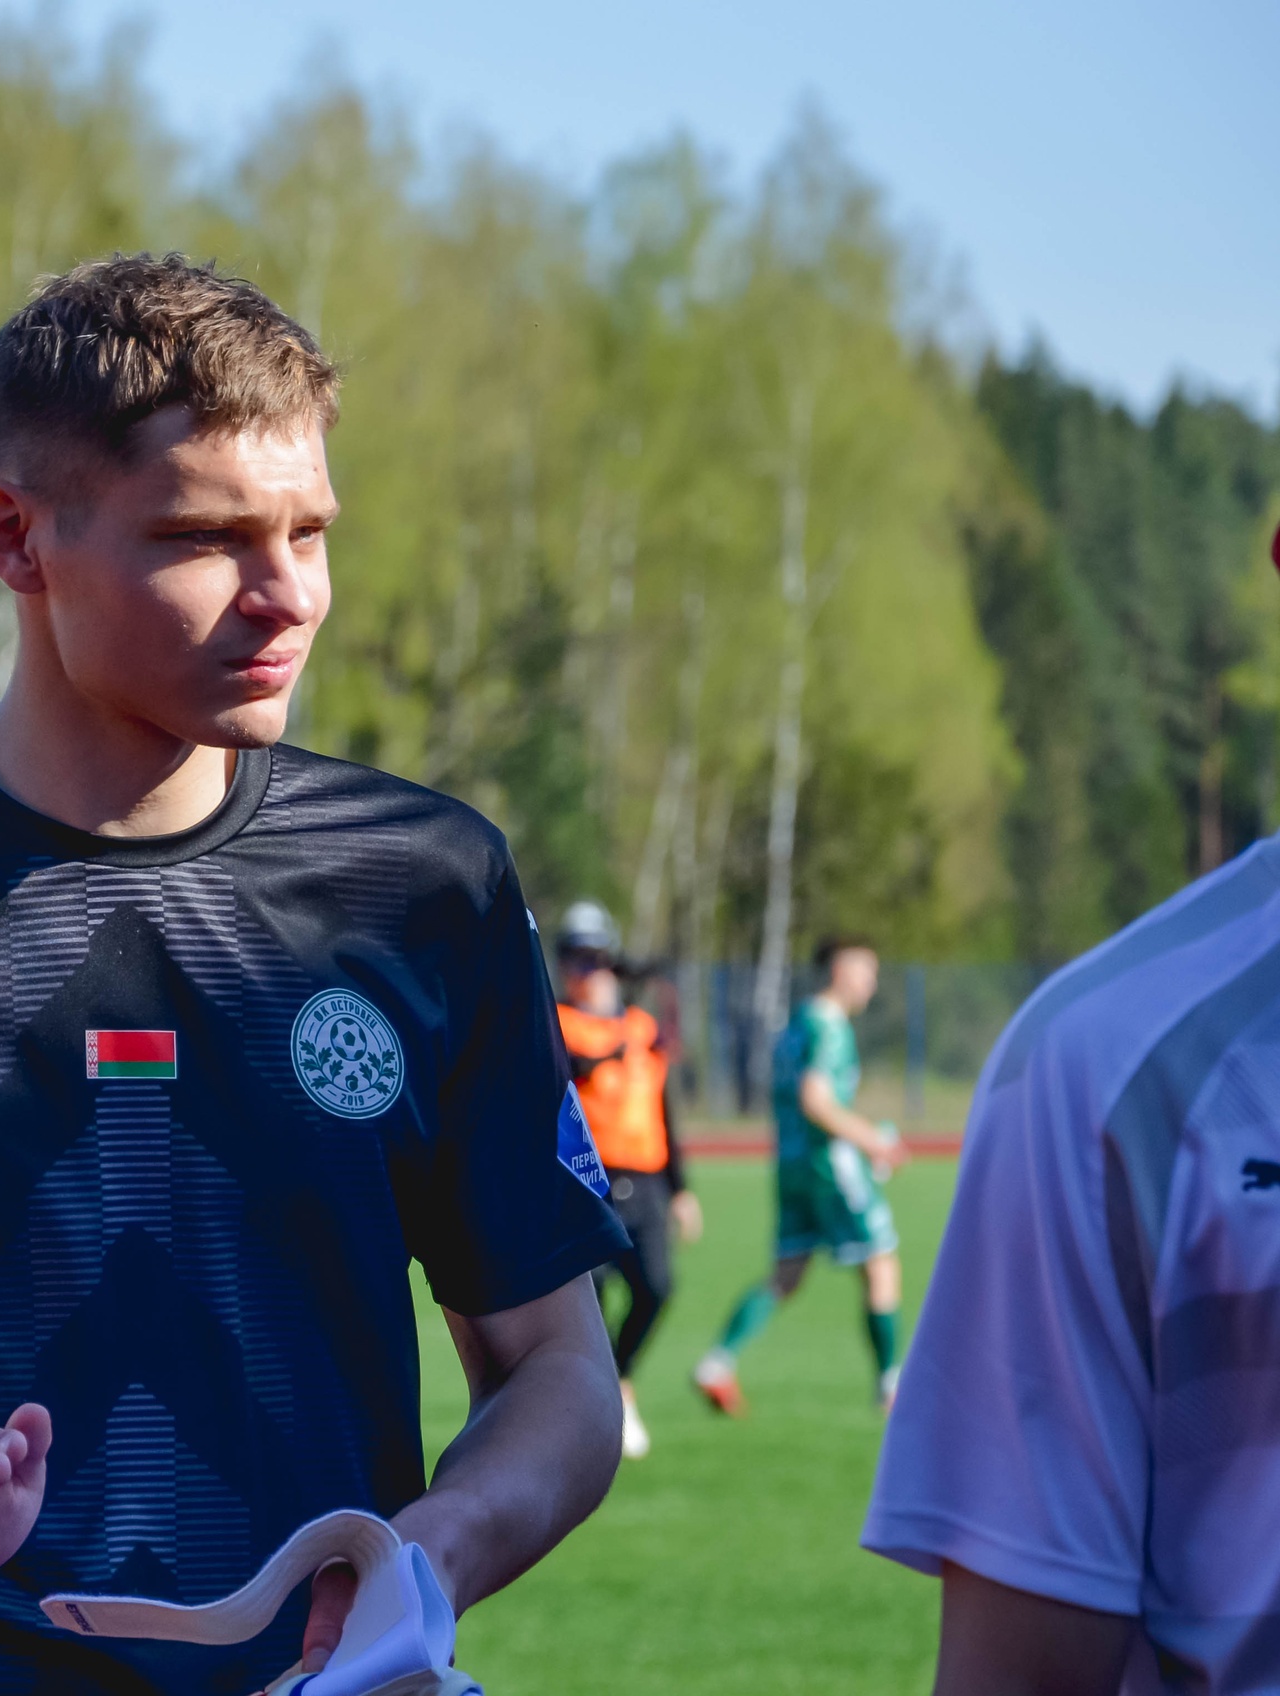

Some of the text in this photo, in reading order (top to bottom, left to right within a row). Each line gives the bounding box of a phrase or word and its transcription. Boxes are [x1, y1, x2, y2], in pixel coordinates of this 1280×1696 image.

[330, 999, 378, 1029] ОСТРОВЕЦ
[339, 1093, 365, 1107] 2019
[571, 1150, 599, 1171] ПЕРВ
